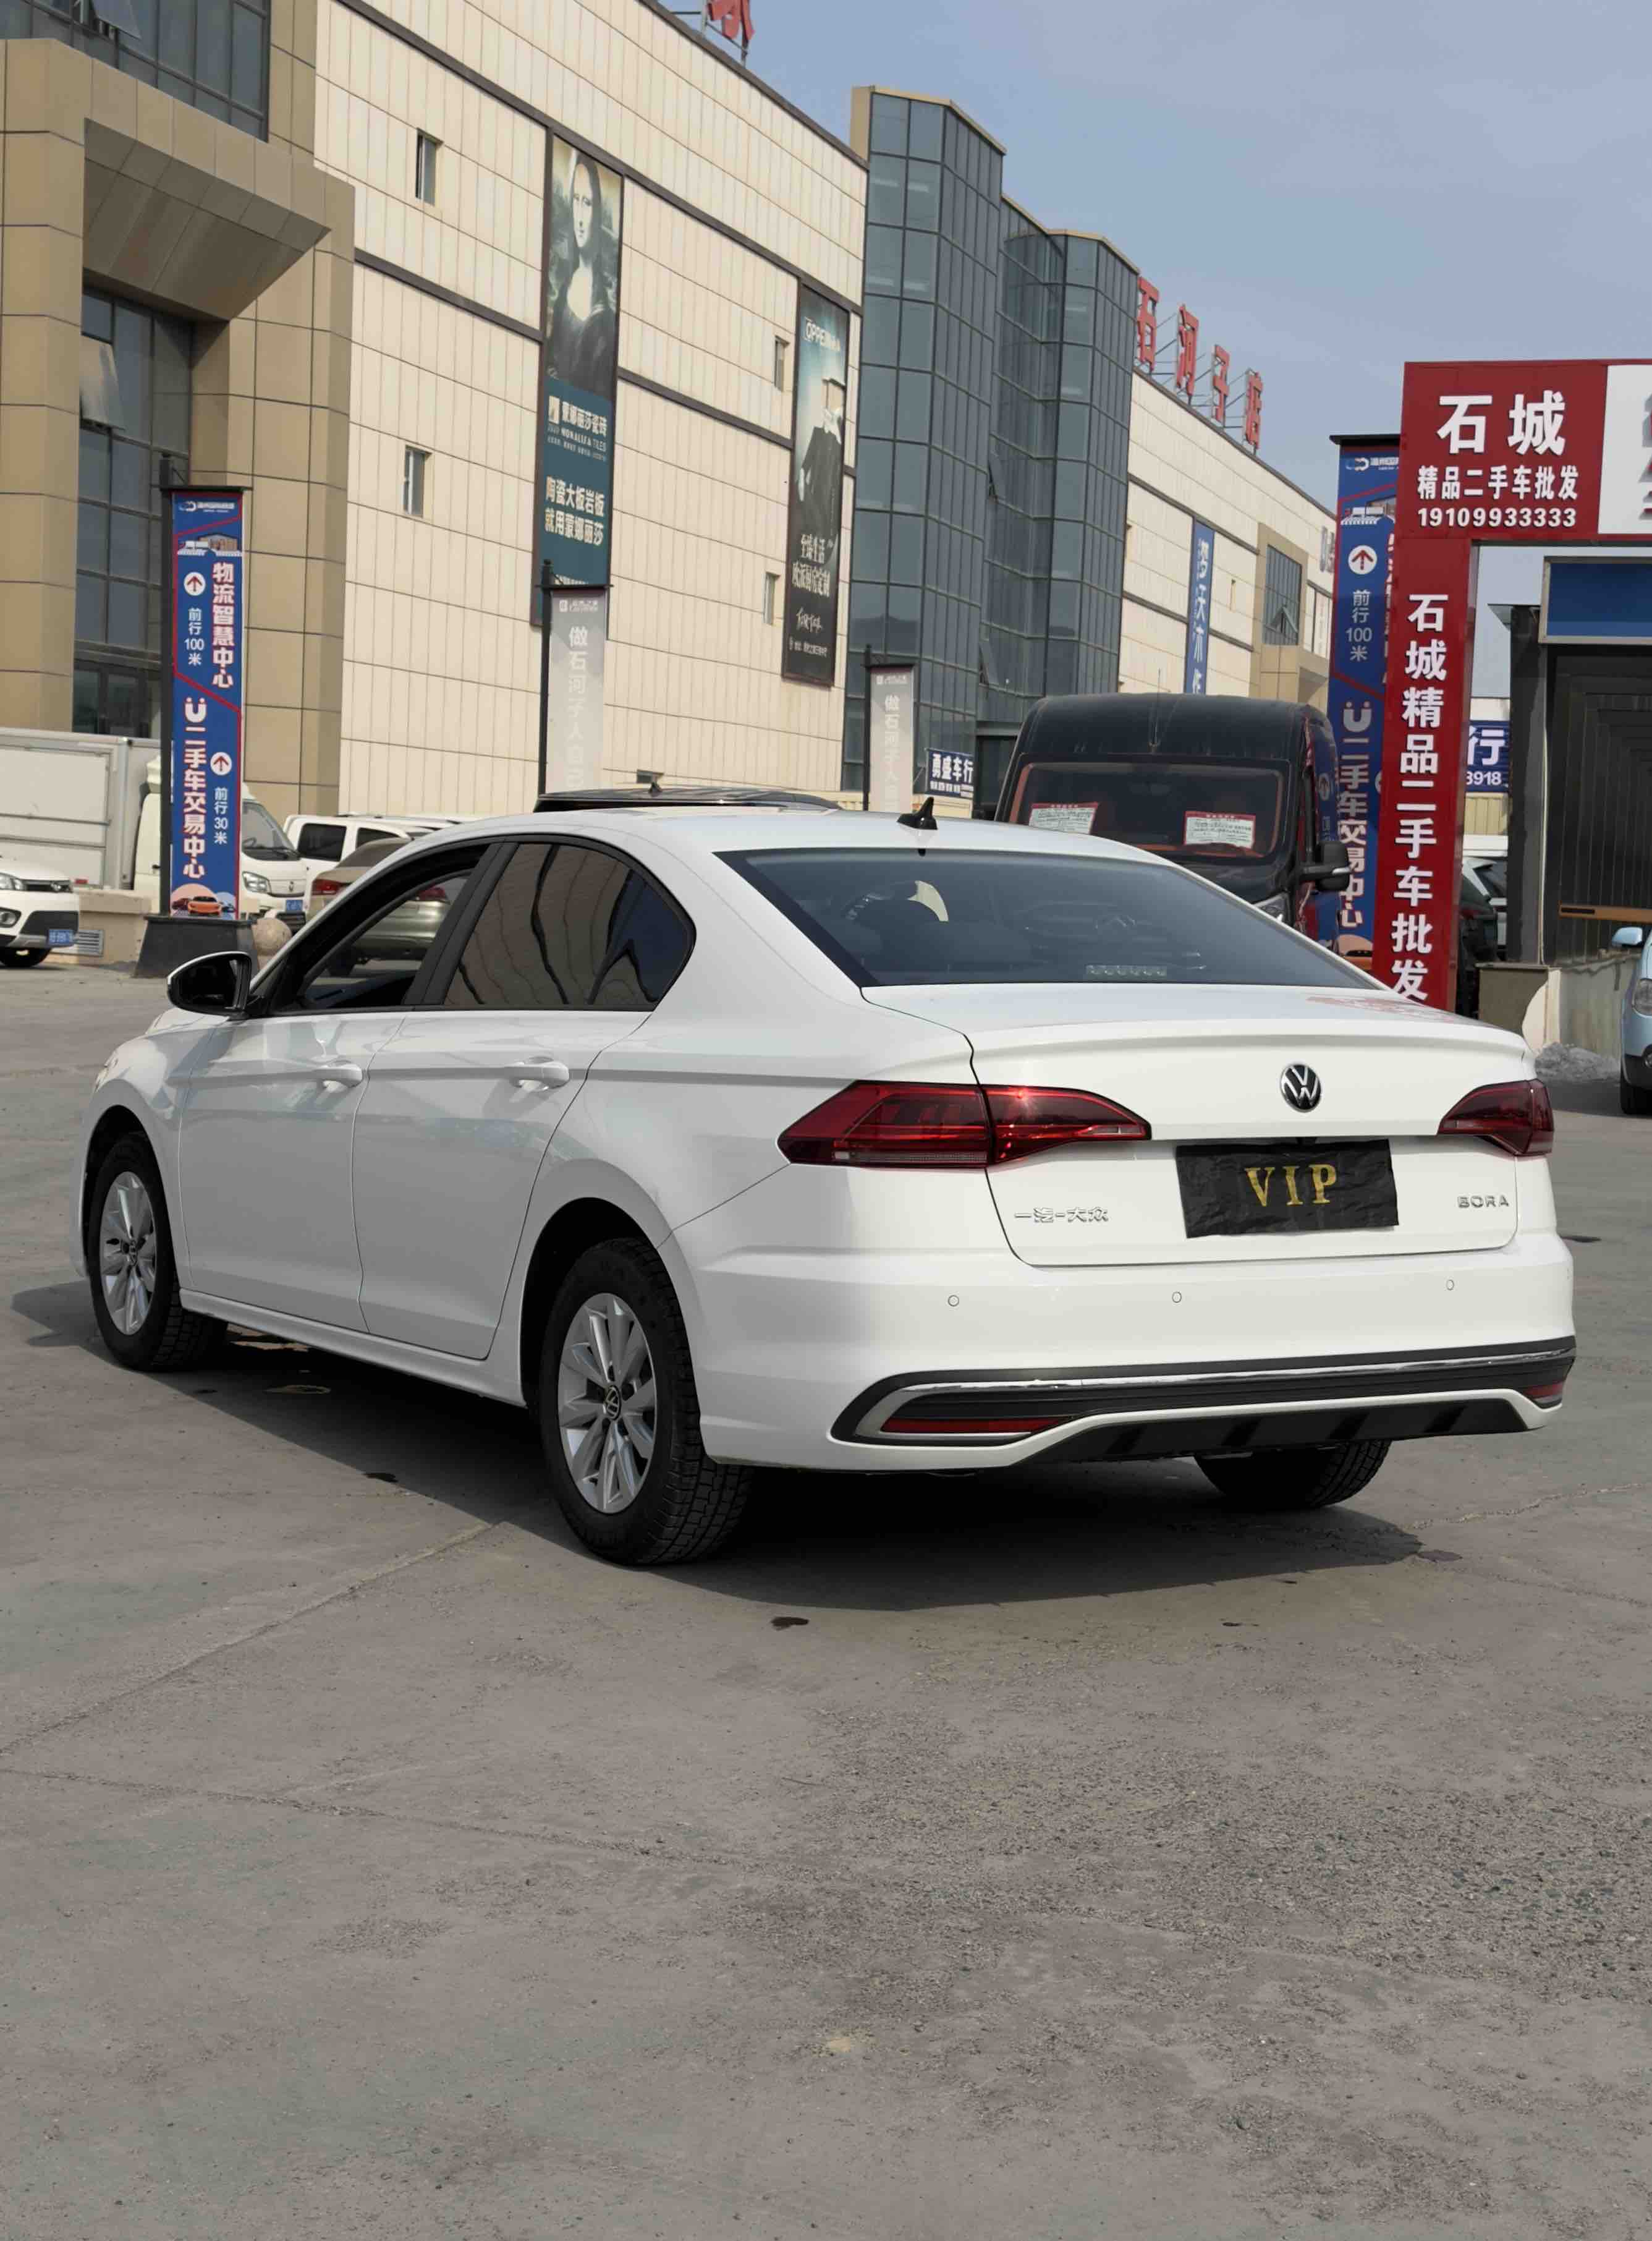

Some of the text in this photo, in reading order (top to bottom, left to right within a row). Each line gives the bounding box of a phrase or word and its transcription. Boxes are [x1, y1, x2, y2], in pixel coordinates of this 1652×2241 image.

[1437, 390, 1565, 455] 石城
[546, 475, 604, 517] 陶瓷大板岩板
[1418, 464, 1578, 500] 精品二手车批发
[544, 508, 603, 546] 就用蒙娜丽莎
[1418, 508, 1577, 527] 19109933333
[213, 562, 234, 689] 物流智慧中心
[1467, 725, 1506, 765] 行
[1392, 594, 1449, 1000] 石城精品二手车批发
[1244, 1163, 1337, 1207] VIP
[1457, 1194, 1509, 1208] BORA
